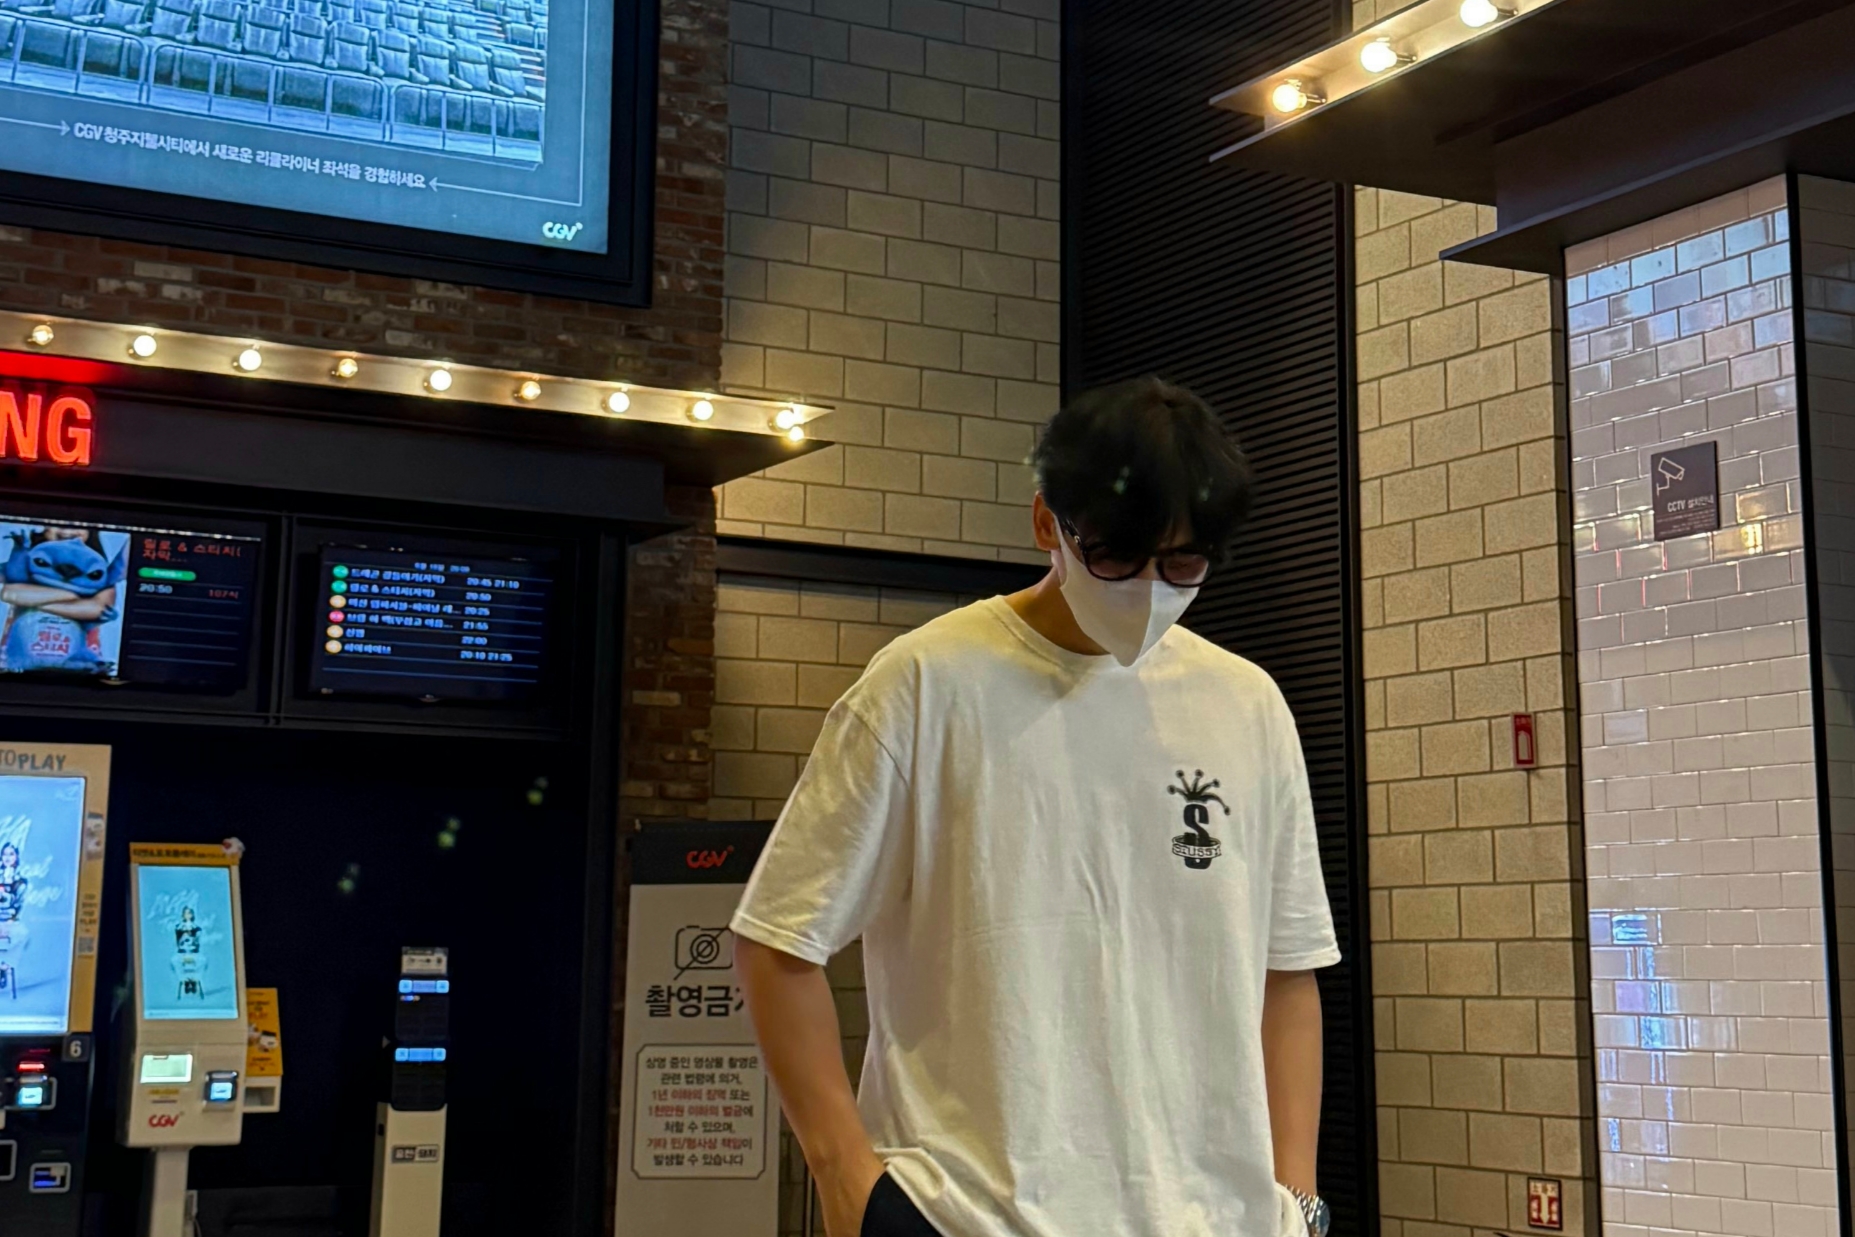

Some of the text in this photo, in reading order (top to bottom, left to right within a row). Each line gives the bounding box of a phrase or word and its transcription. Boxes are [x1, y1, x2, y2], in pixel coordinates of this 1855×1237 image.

[74, 122, 103, 140] CGV
[212, 144, 253, 163] 새로운
[256, 150, 320, 174] 리클라이너
[322, 160, 361, 180] 좌석을
[364, 166, 426, 188] 경험하세요
[542, 221, 583, 241] CGV
[0, 390, 92, 466] NG
[1667, 499, 1686, 513] CCTV
[685, 845, 734, 868] CGV
[645, 985, 744, 1018] 촬영금
[69, 1040, 82, 1056] 6
[149, 1113, 182, 1128] CGV
[688, 1121, 699, 1133] 수
[688, 1154, 698, 1166] 수
